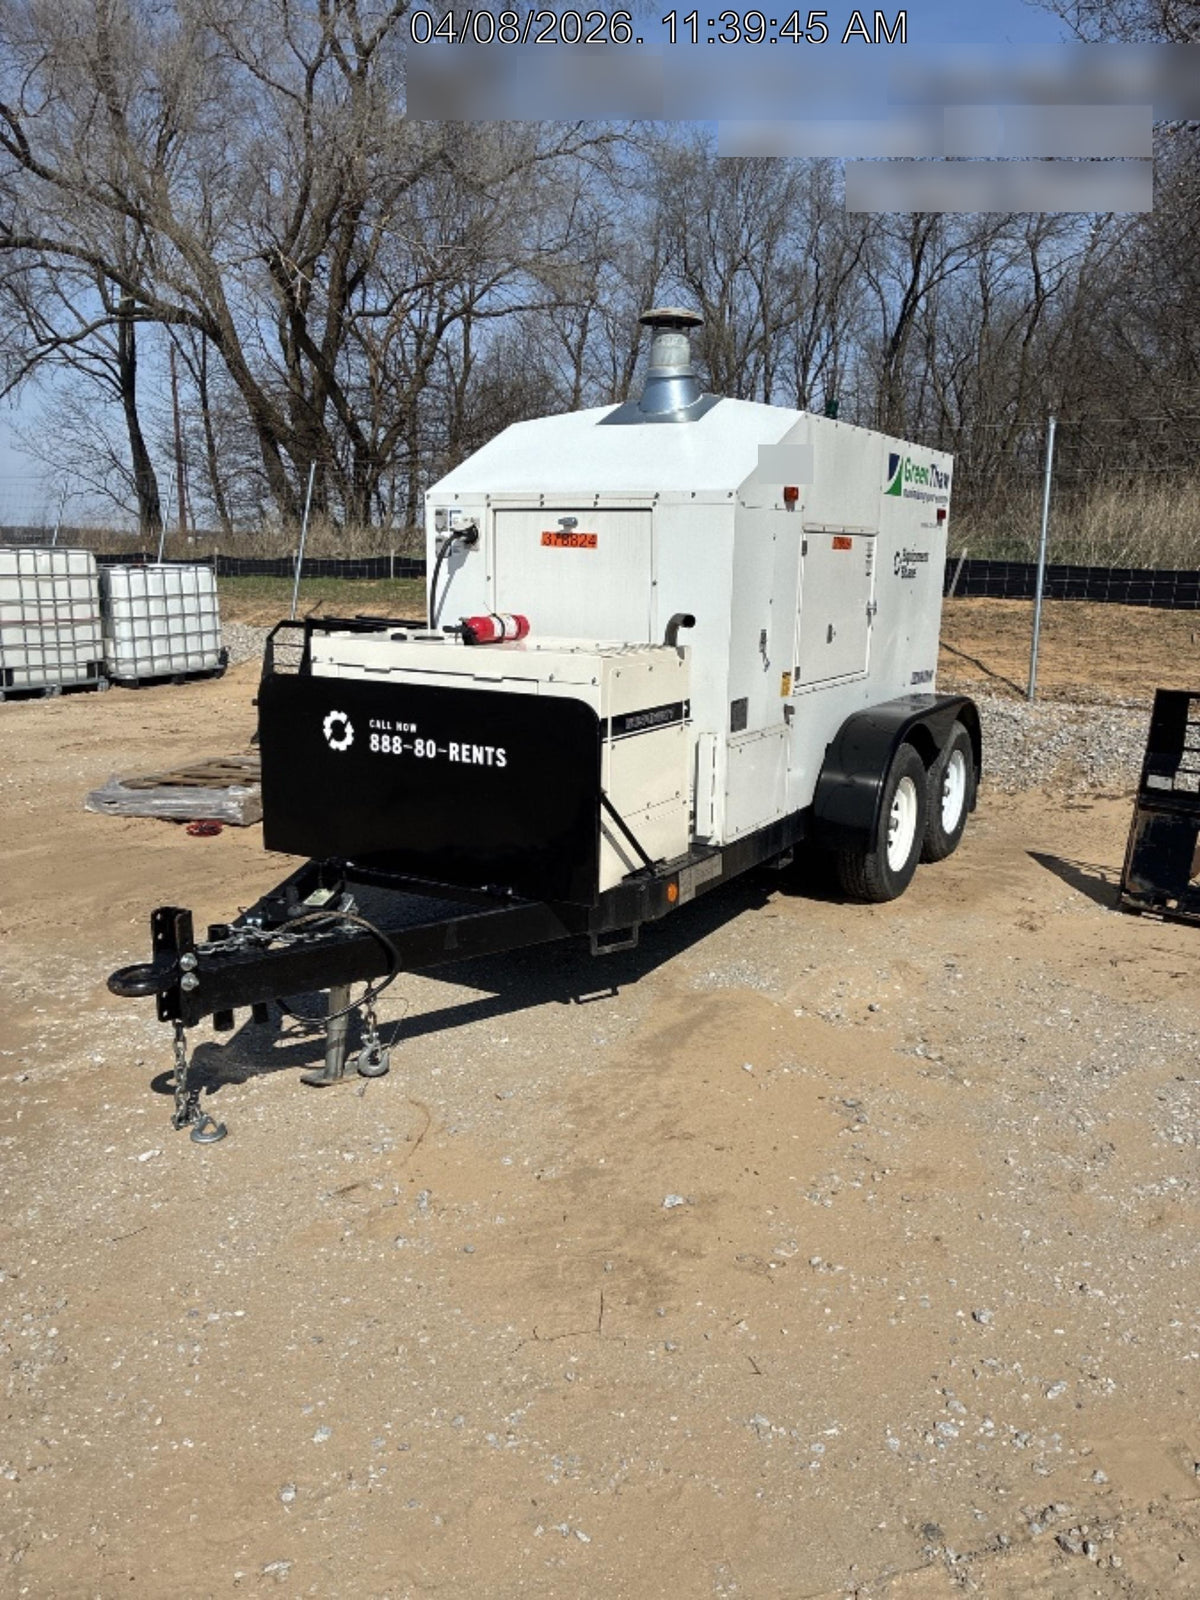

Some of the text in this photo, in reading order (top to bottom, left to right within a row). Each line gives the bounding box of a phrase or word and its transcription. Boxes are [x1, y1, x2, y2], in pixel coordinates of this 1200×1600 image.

[369, 718, 417, 733] CALL NOW
[369, 733, 507, 768] 888-80-RENTS
